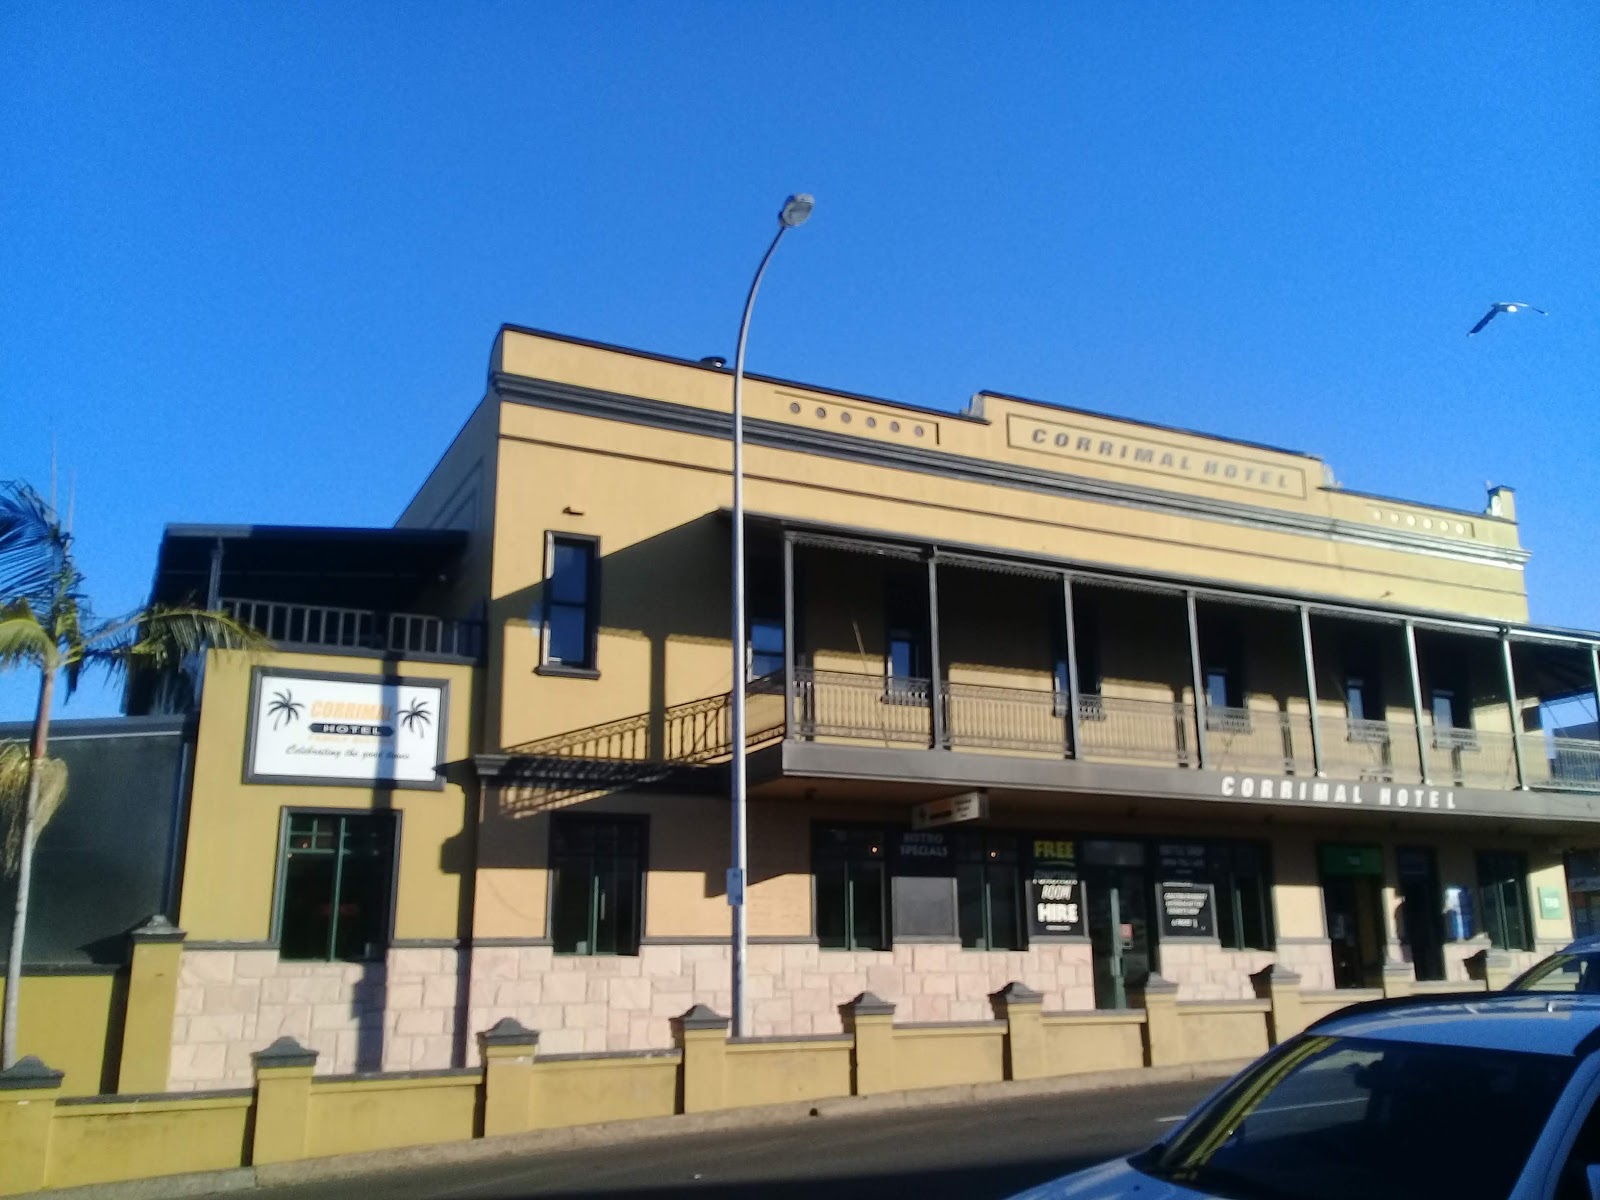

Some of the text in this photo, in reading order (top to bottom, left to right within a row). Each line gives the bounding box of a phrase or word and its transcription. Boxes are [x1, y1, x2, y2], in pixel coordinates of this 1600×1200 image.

[1031, 428, 1288, 489] CORRIMAL HOTEL
[323, 723, 381, 735] HOTEL
[1221, 776, 1456, 810] CORRIMAL HOTEL
[1034, 840, 1075, 859] FREE
[1037, 903, 1079, 923] HIRE
